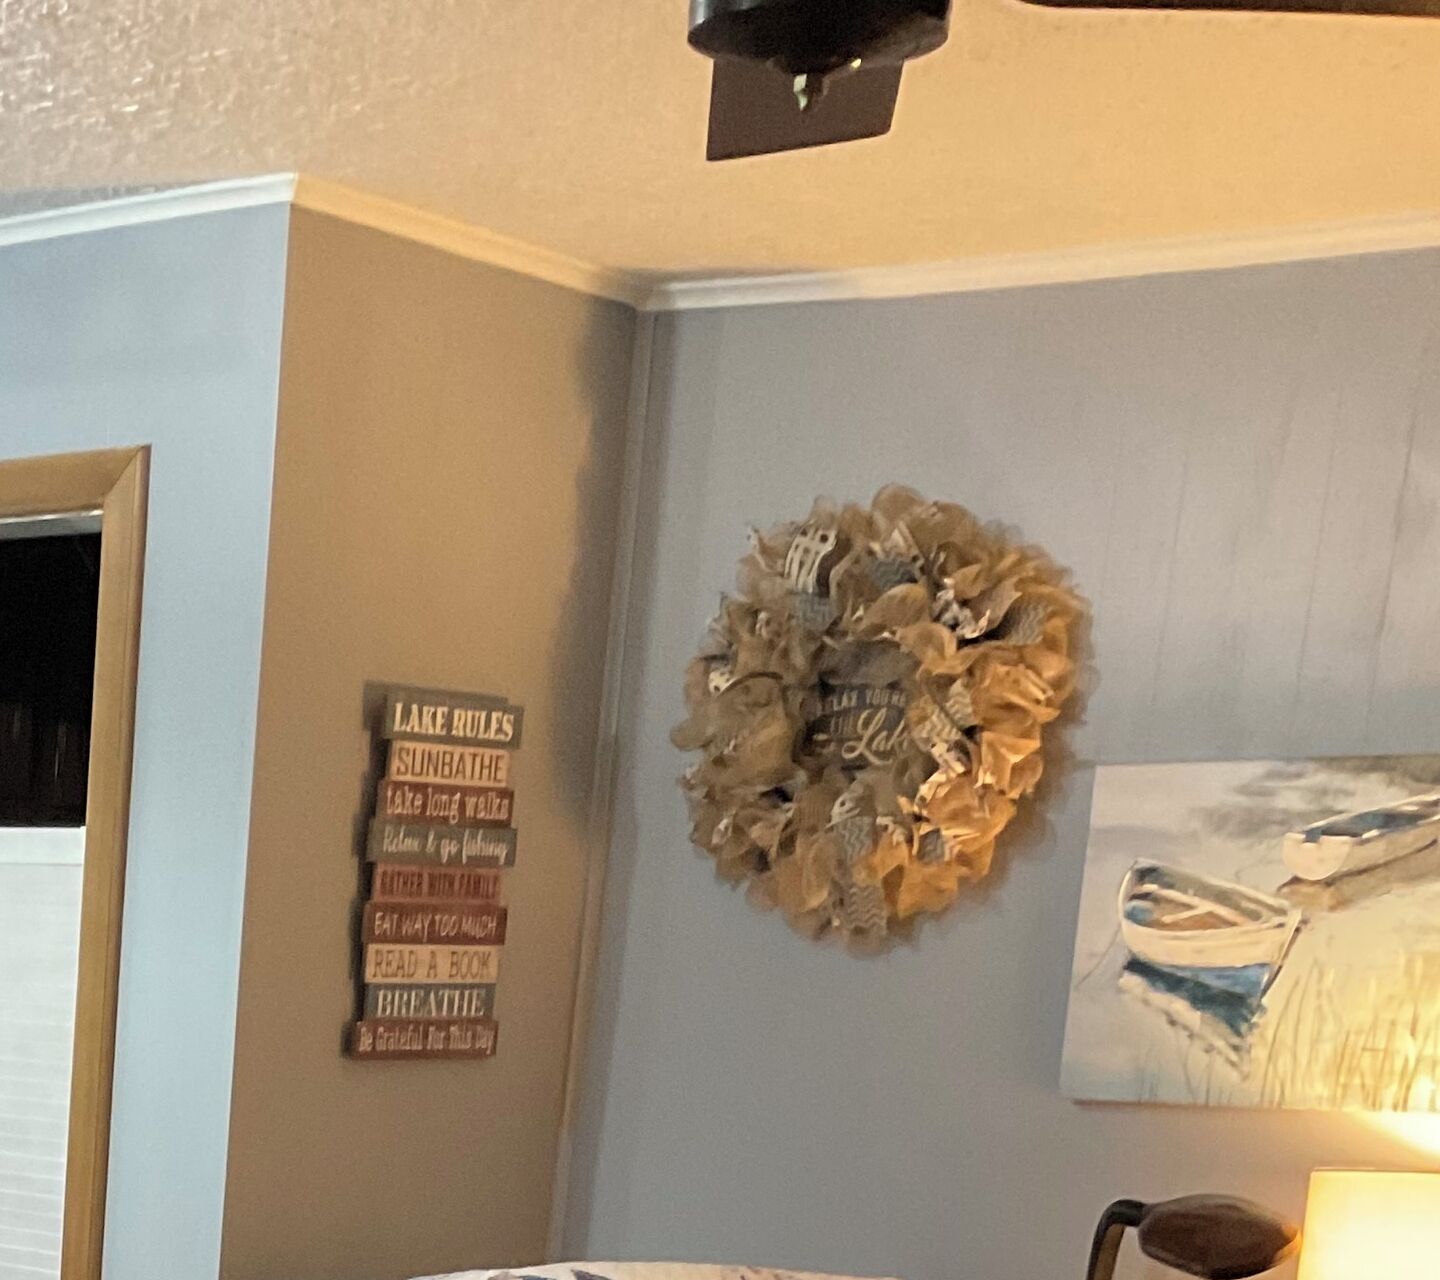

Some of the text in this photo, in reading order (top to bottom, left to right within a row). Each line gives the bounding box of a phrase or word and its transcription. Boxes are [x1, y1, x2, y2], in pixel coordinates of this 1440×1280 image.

[393, 702, 514, 742] LAKE RULES
[396, 747, 504, 783] SUNBATHE
[386, 785, 509, 824] take long walks
[383, 824, 421, 852] Relax
[440, 839, 459, 864] go
[462, 828, 508, 865] fishing
[374, 911, 497, 942] EAT WAY TOO MUCH
[372, 949, 491, 980] READ A BOOK
[376, 988, 486, 1018] BREATHE
[375, 1024, 423, 1051] Grateful
